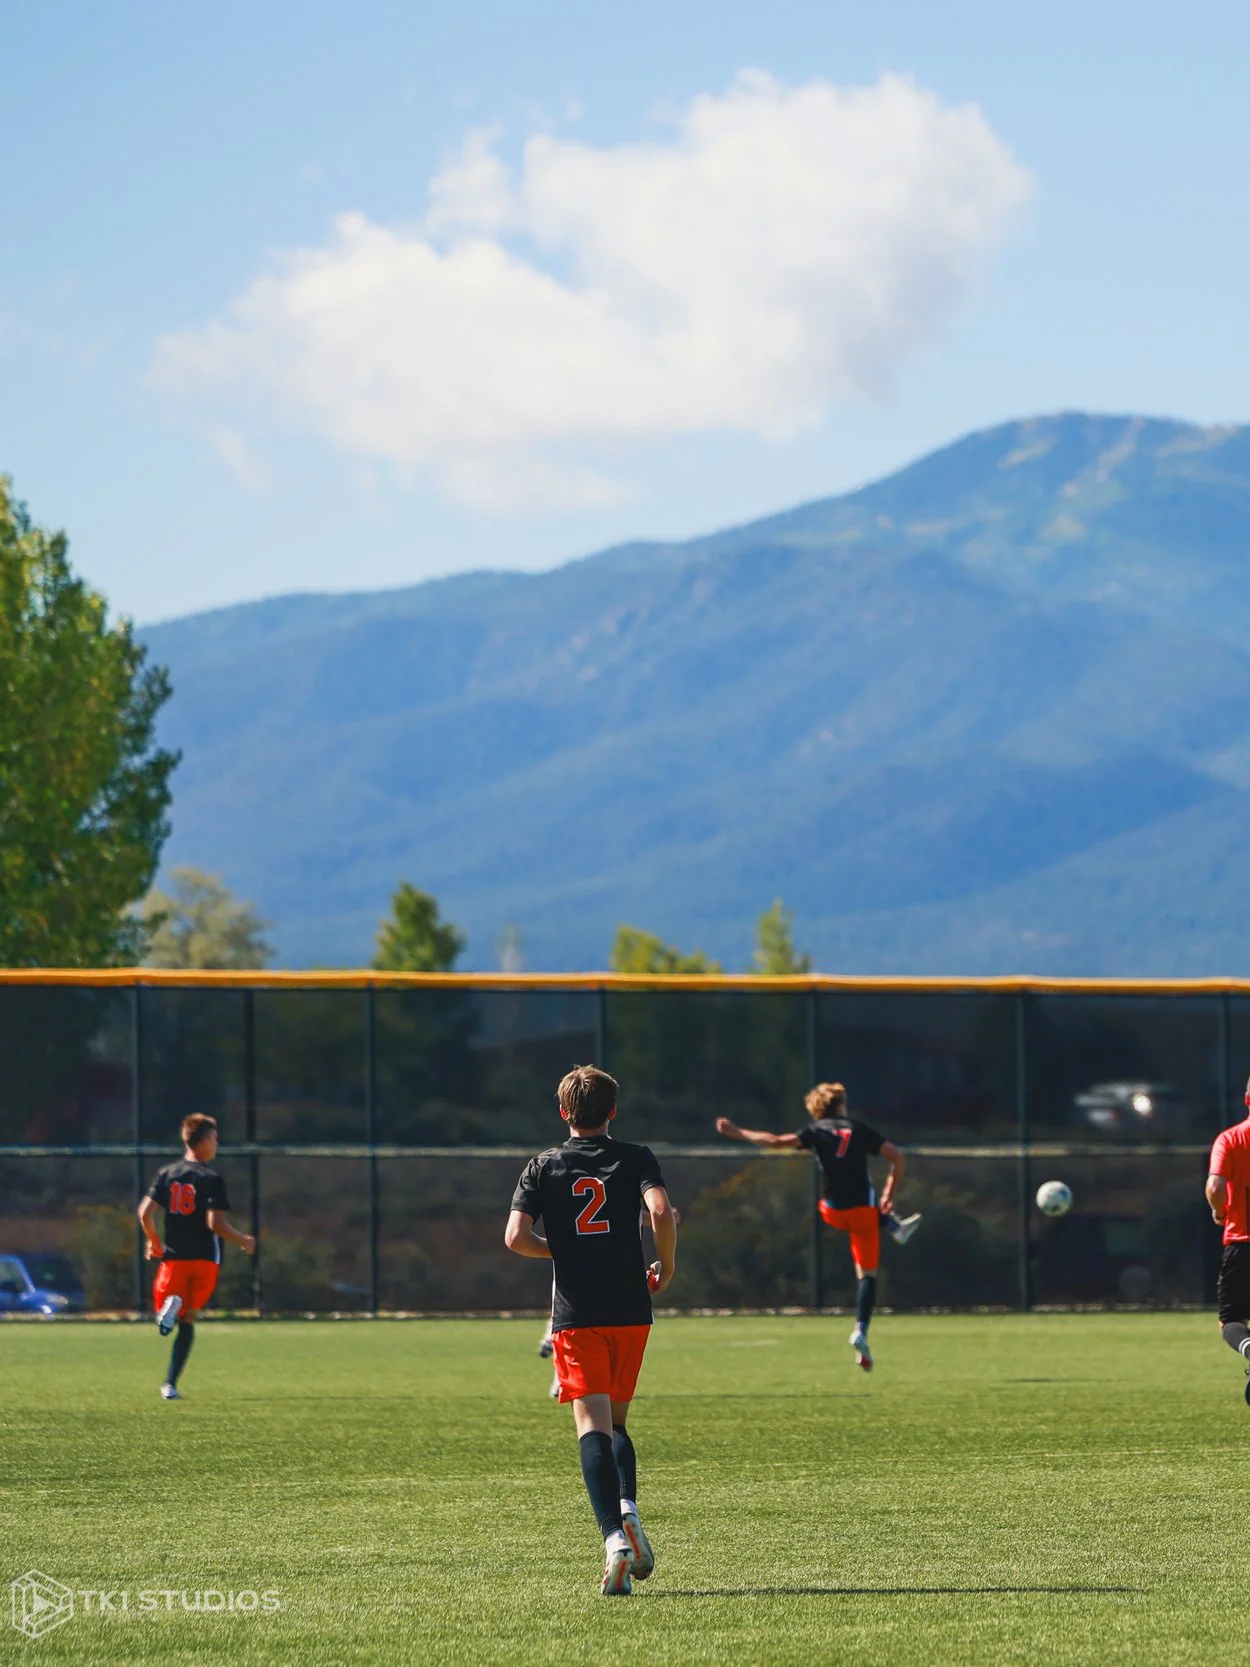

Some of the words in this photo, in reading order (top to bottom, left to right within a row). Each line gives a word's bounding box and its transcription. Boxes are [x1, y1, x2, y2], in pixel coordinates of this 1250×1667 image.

[832, 1128, 852, 1158] 7
[170, 1181, 197, 1215] 18
[572, 1176, 610, 1235] 2
